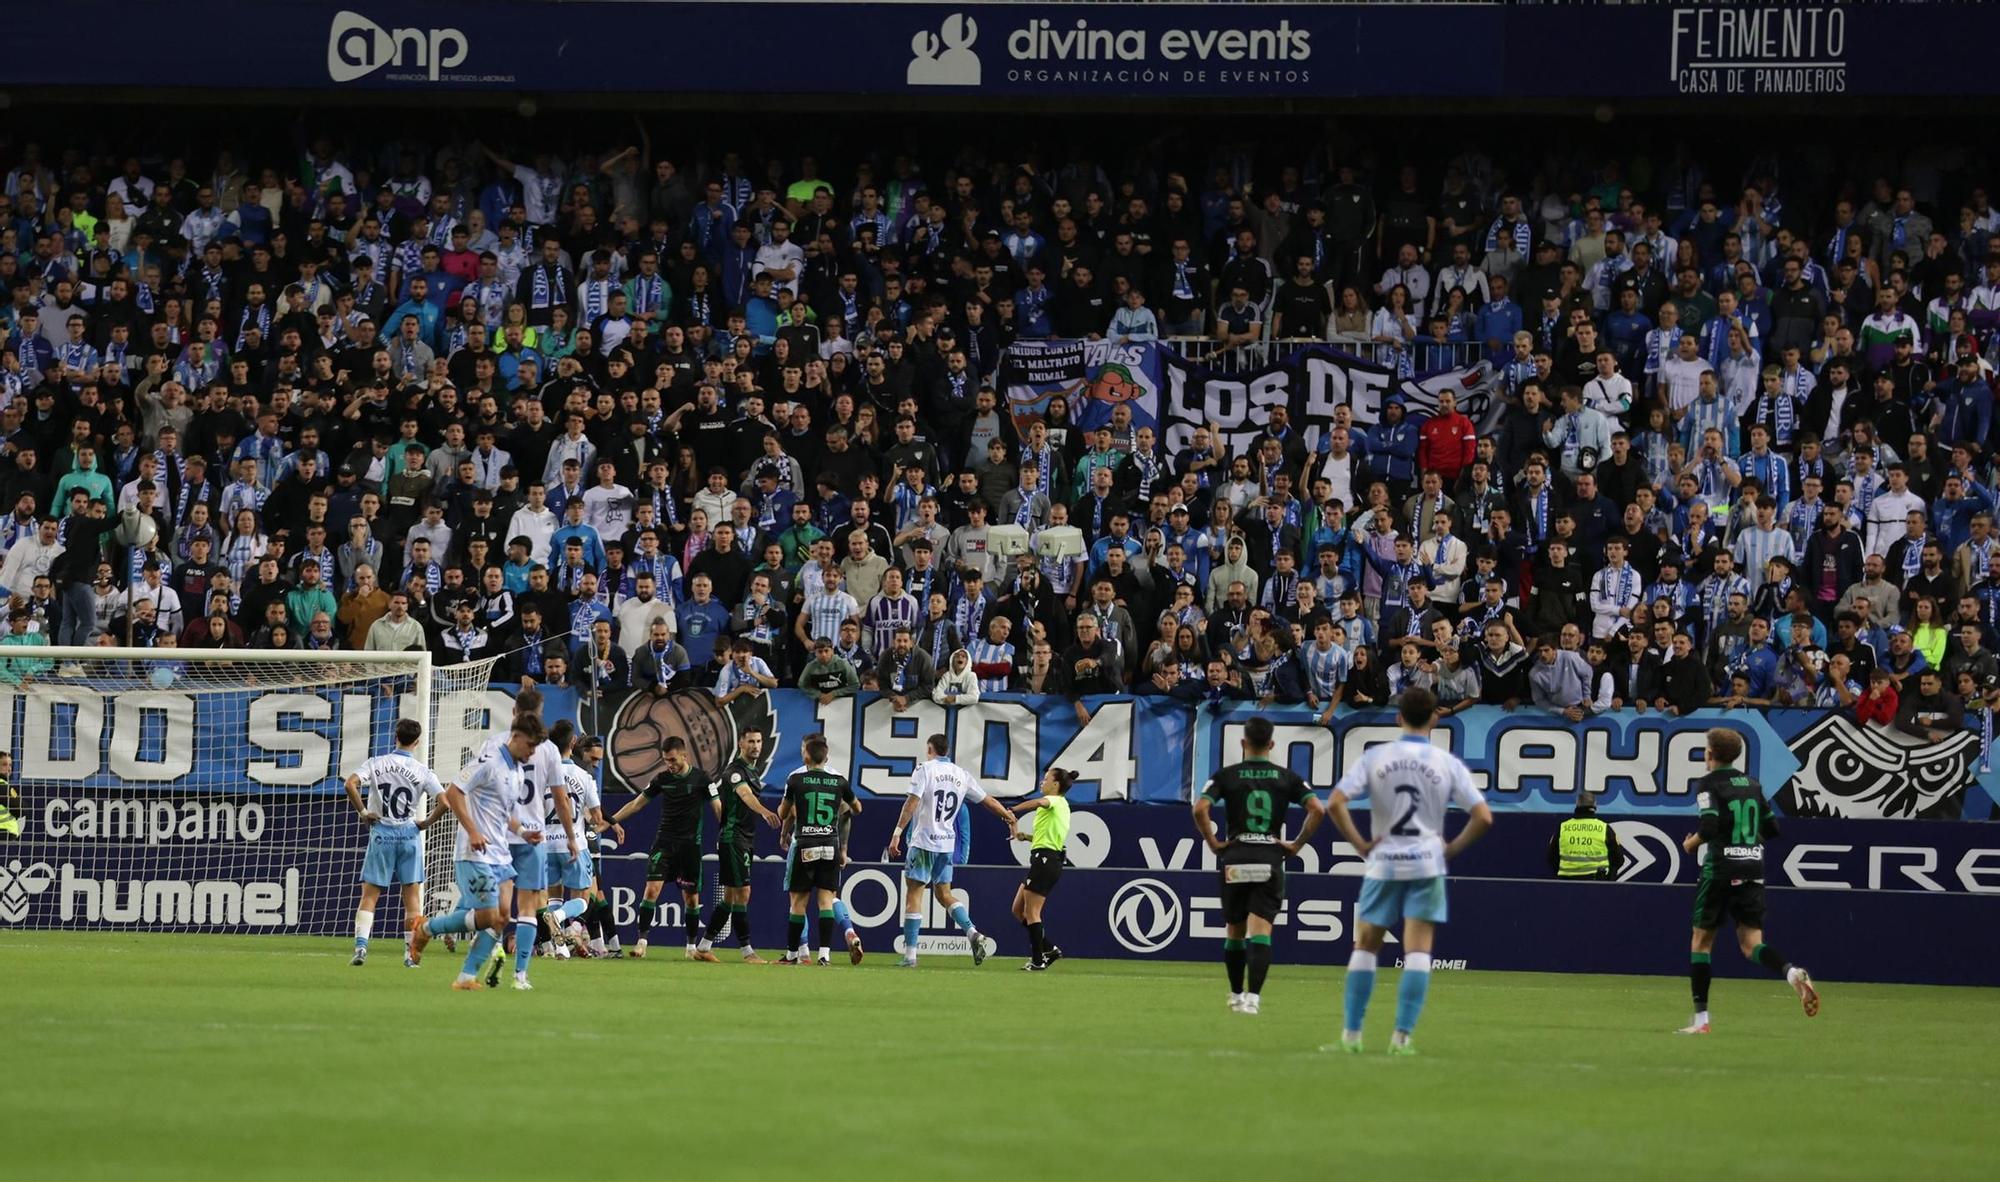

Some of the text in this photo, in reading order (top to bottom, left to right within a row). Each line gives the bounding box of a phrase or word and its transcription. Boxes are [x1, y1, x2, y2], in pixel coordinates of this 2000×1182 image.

[337, 26, 469, 82] anp
[1008, 19, 1311, 61] divina events
[1671, 8, 1845, 81] FERMENTO
[1007, 67, 1310, 82] ORGANIZACIÓN DE EVENTOS
[1679, 69, 1846, 93] CASA DE PANADEROS
[1027, 354, 1080, 369] MALTRATO
[1028, 370, 1067, 382] ANIMAL
[1167, 357, 1391, 429] LOS DE
[1777, 396, 1791, 432] SUR
[816, 690, 1136, 802] 1904
[385, 765, 420, 787] LARRUBIA
[935, 774, 961, 788] ROBERTO
[1377, 760, 1441, 785] GABILONDO
[378, 782, 413, 819] 10
[804, 791, 837, 826] 15
[934, 789, 959, 822] 19
[1246, 790, 1272, 833] 9
[1390, 784, 1421, 836] 2
[44, 797, 266, 846] campano
[1563, 823, 1604, 833] SEGURIDAD
[1728, 799, 1759, 845] 10
[1569, 836, 1593, 846] 0120
[60, 863, 300, 927] hummel
[611, 886, 707, 928] Bn
[938, 940, 967, 951] móvil
